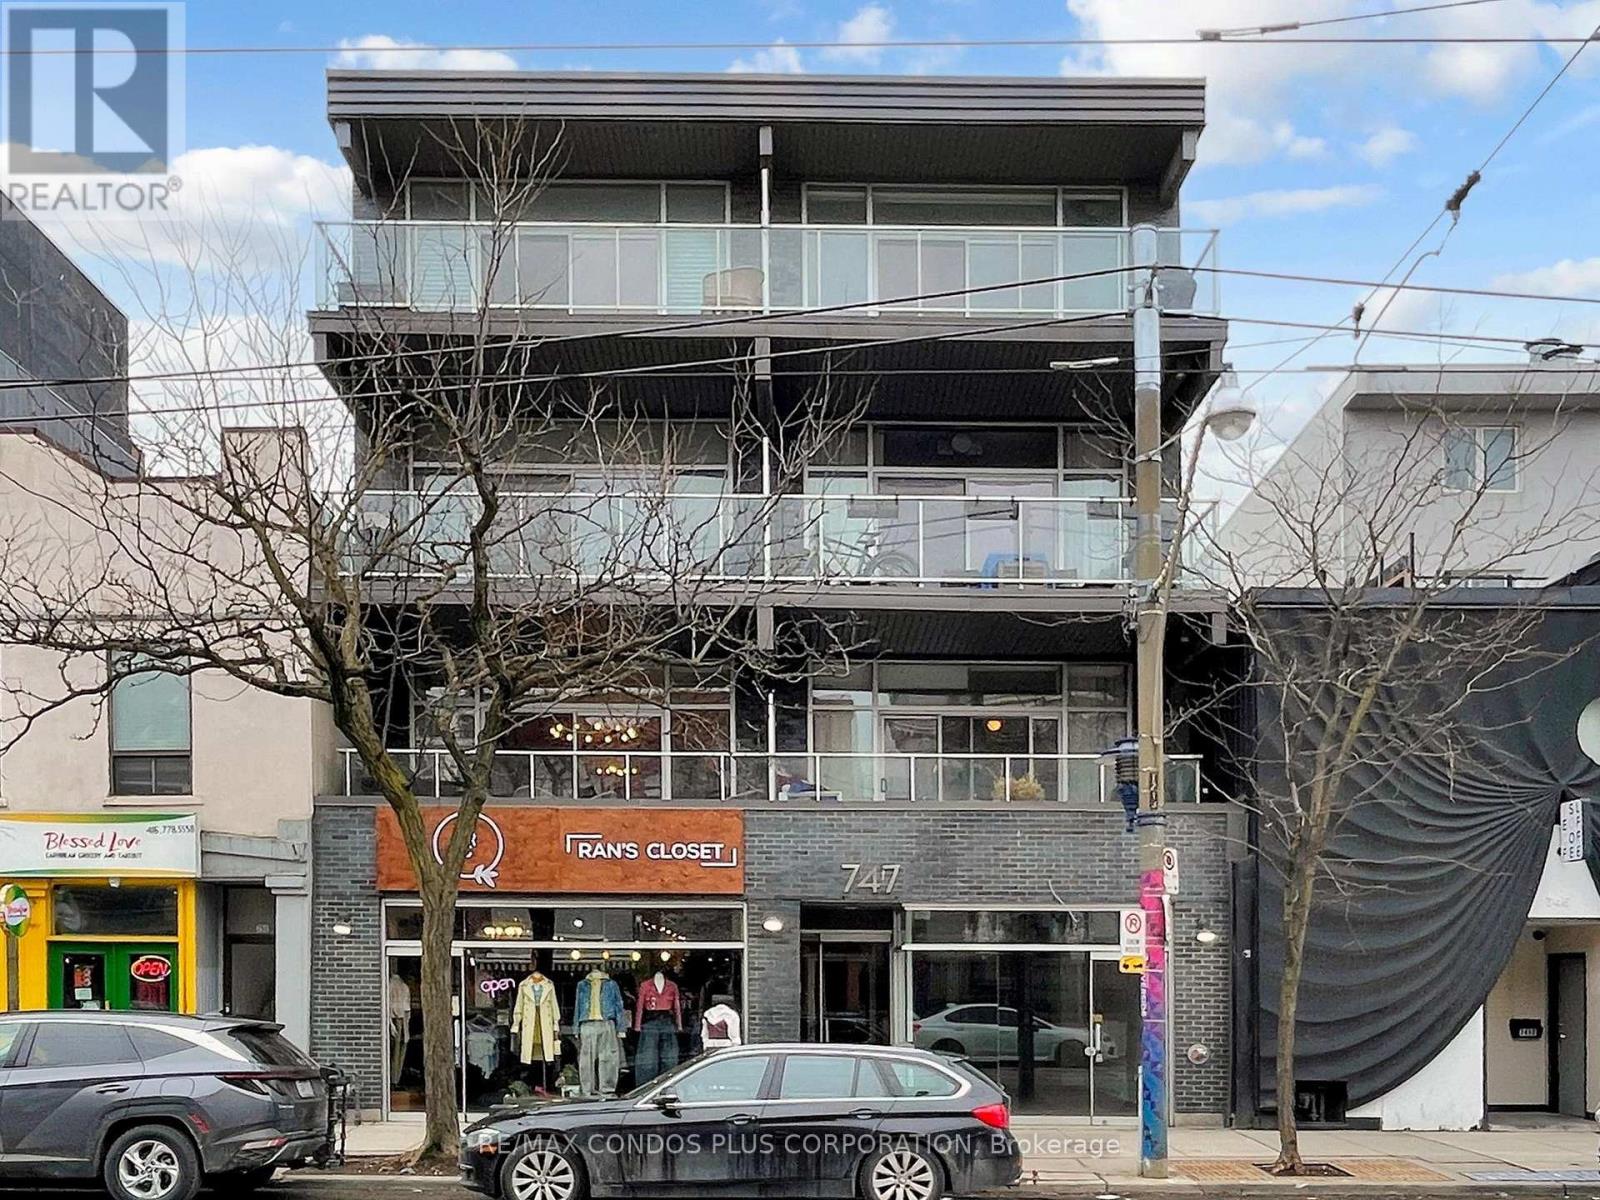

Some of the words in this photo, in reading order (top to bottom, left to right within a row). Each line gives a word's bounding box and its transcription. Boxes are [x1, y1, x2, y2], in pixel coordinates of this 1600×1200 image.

[44, 831, 106, 850] Blessed
[109, 831, 142, 852] Love
[578, 842, 640, 859] RAN'S
[646, 842, 725, 860] CLOSET
[841, 863, 901, 893] 747
[135, 962, 168, 976] OPEN
[480, 978, 515, 998] open
